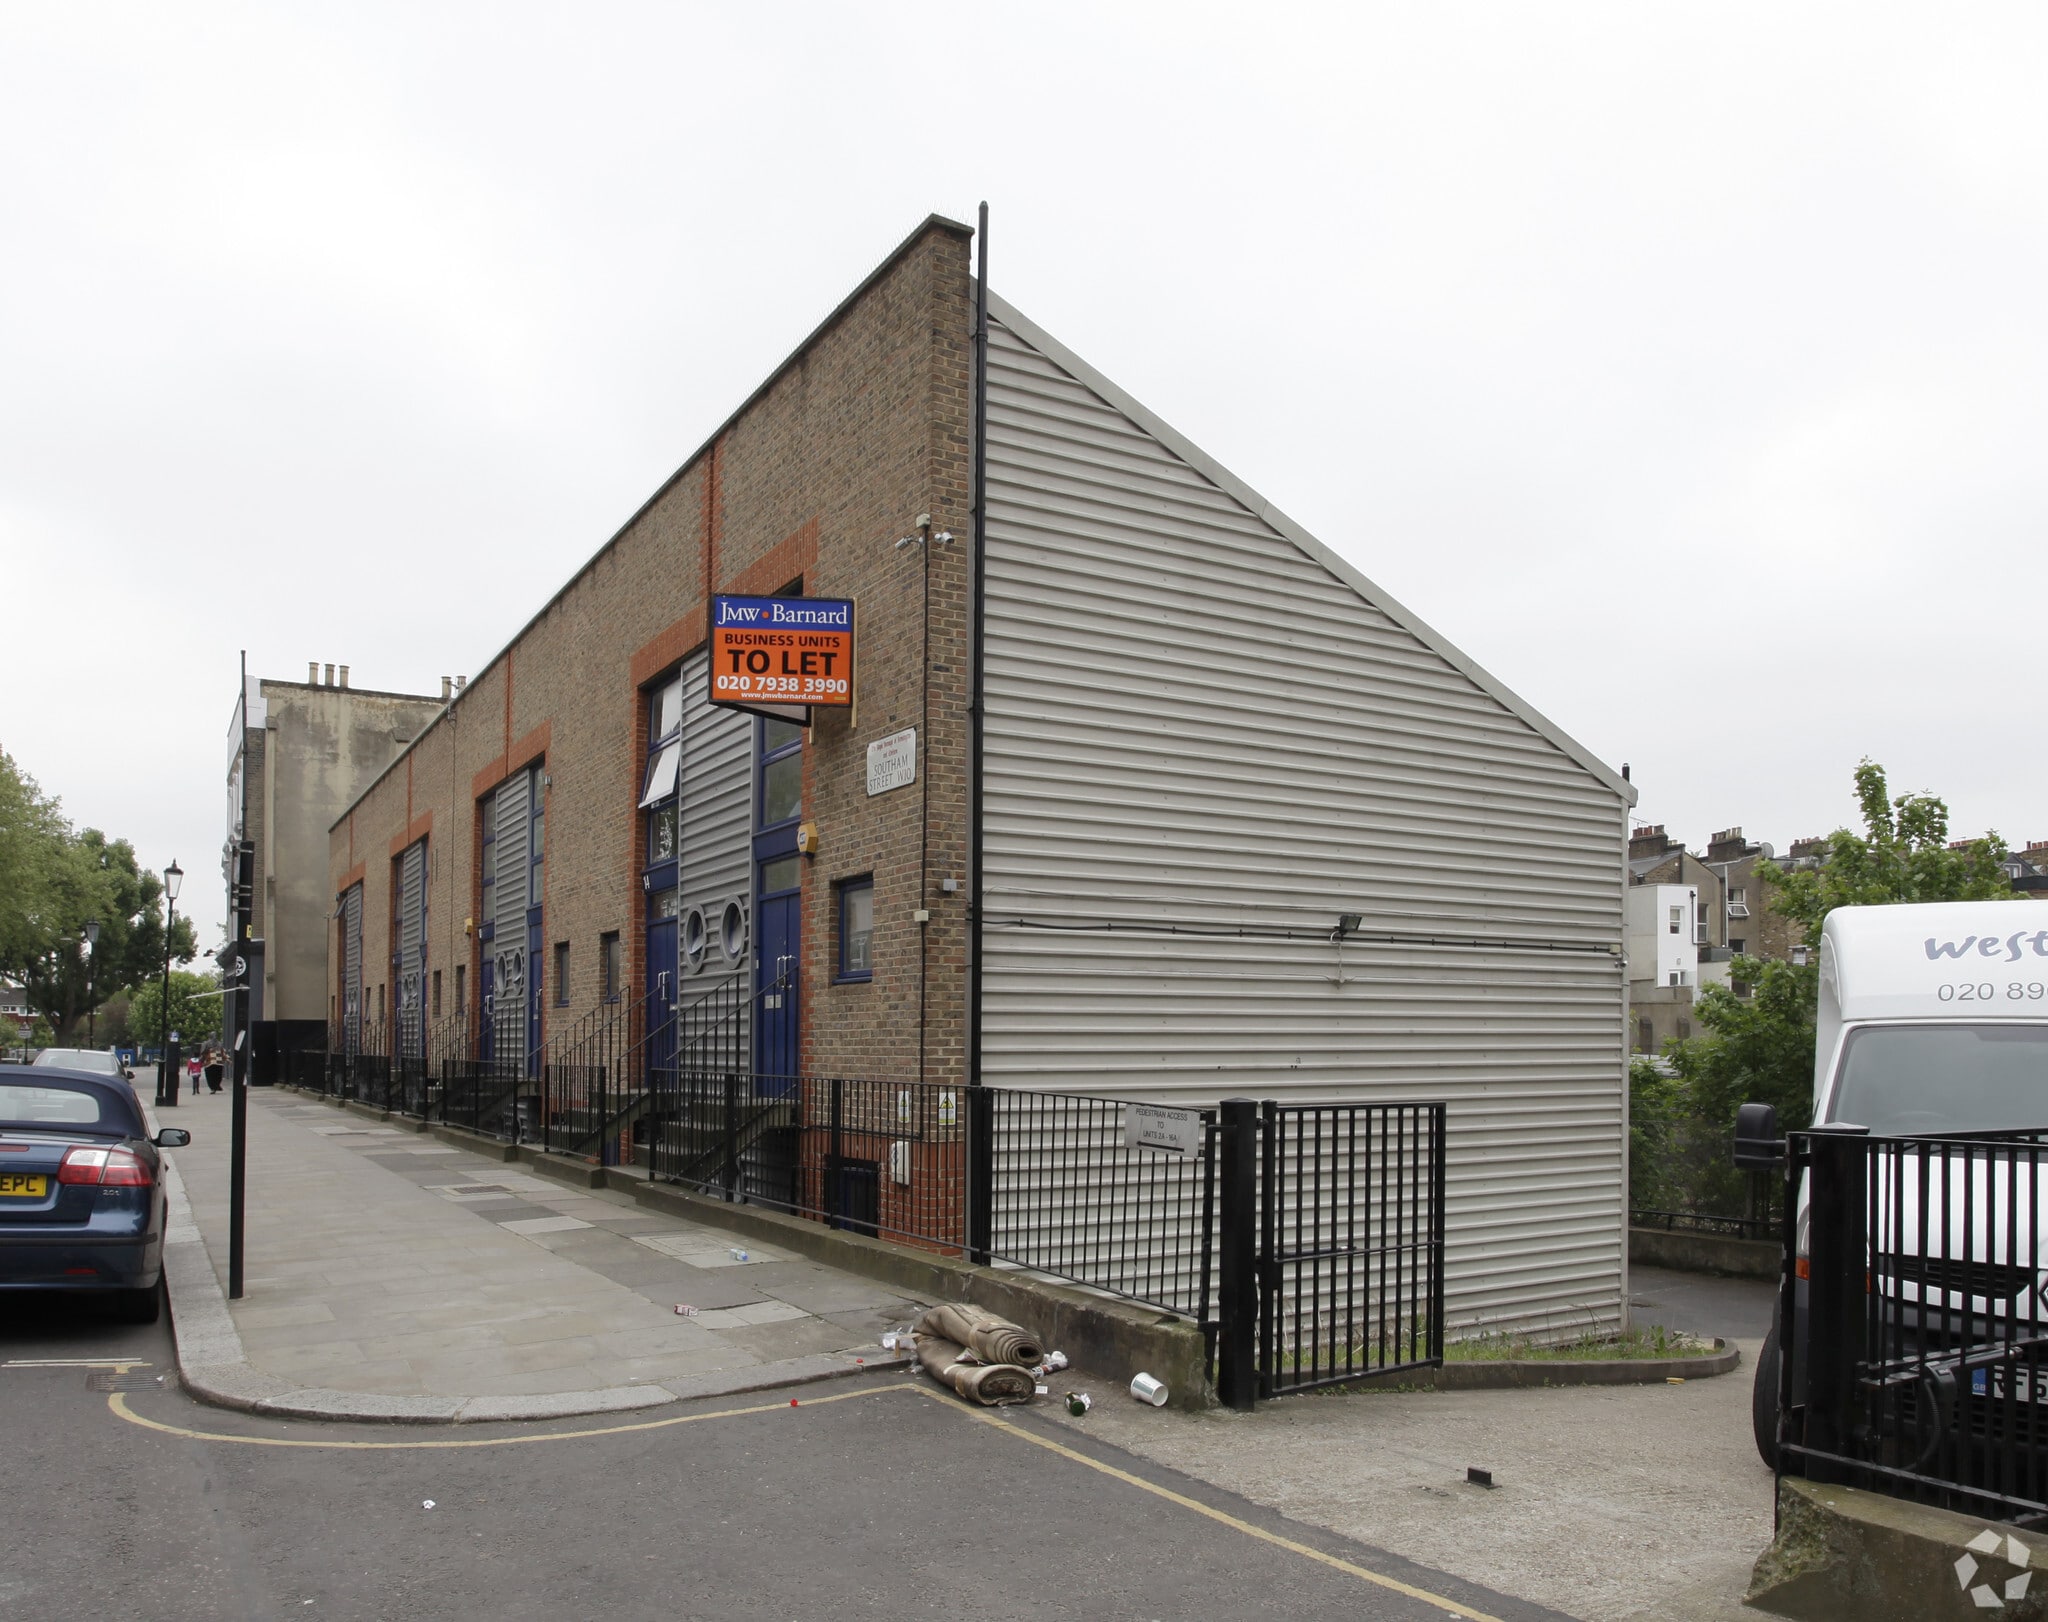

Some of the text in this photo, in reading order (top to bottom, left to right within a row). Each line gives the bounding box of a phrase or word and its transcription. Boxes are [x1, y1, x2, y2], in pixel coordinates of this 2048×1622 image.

[772, 603, 848, 624] Barnard
[724, 634, 840, 647] BUSINESS UNITS
[727, 649, 837, 676] TO LET
[717, 675, 848, 693] 020 7938 3990
[741, 691, 823, 700] www.jmwbarnard.com
[874, 754, 908, 776] SOUTHAM
[869, 773, 893, 791] STREET
[1938, 982, 2048, 1001] 020 89
[1136, 1108, 1188, 1121] PEDESTRIAN ACCESS
[1157, 1121, 1165, 1129] TO
[1143, 1130, 1157, 1139] UNITS
